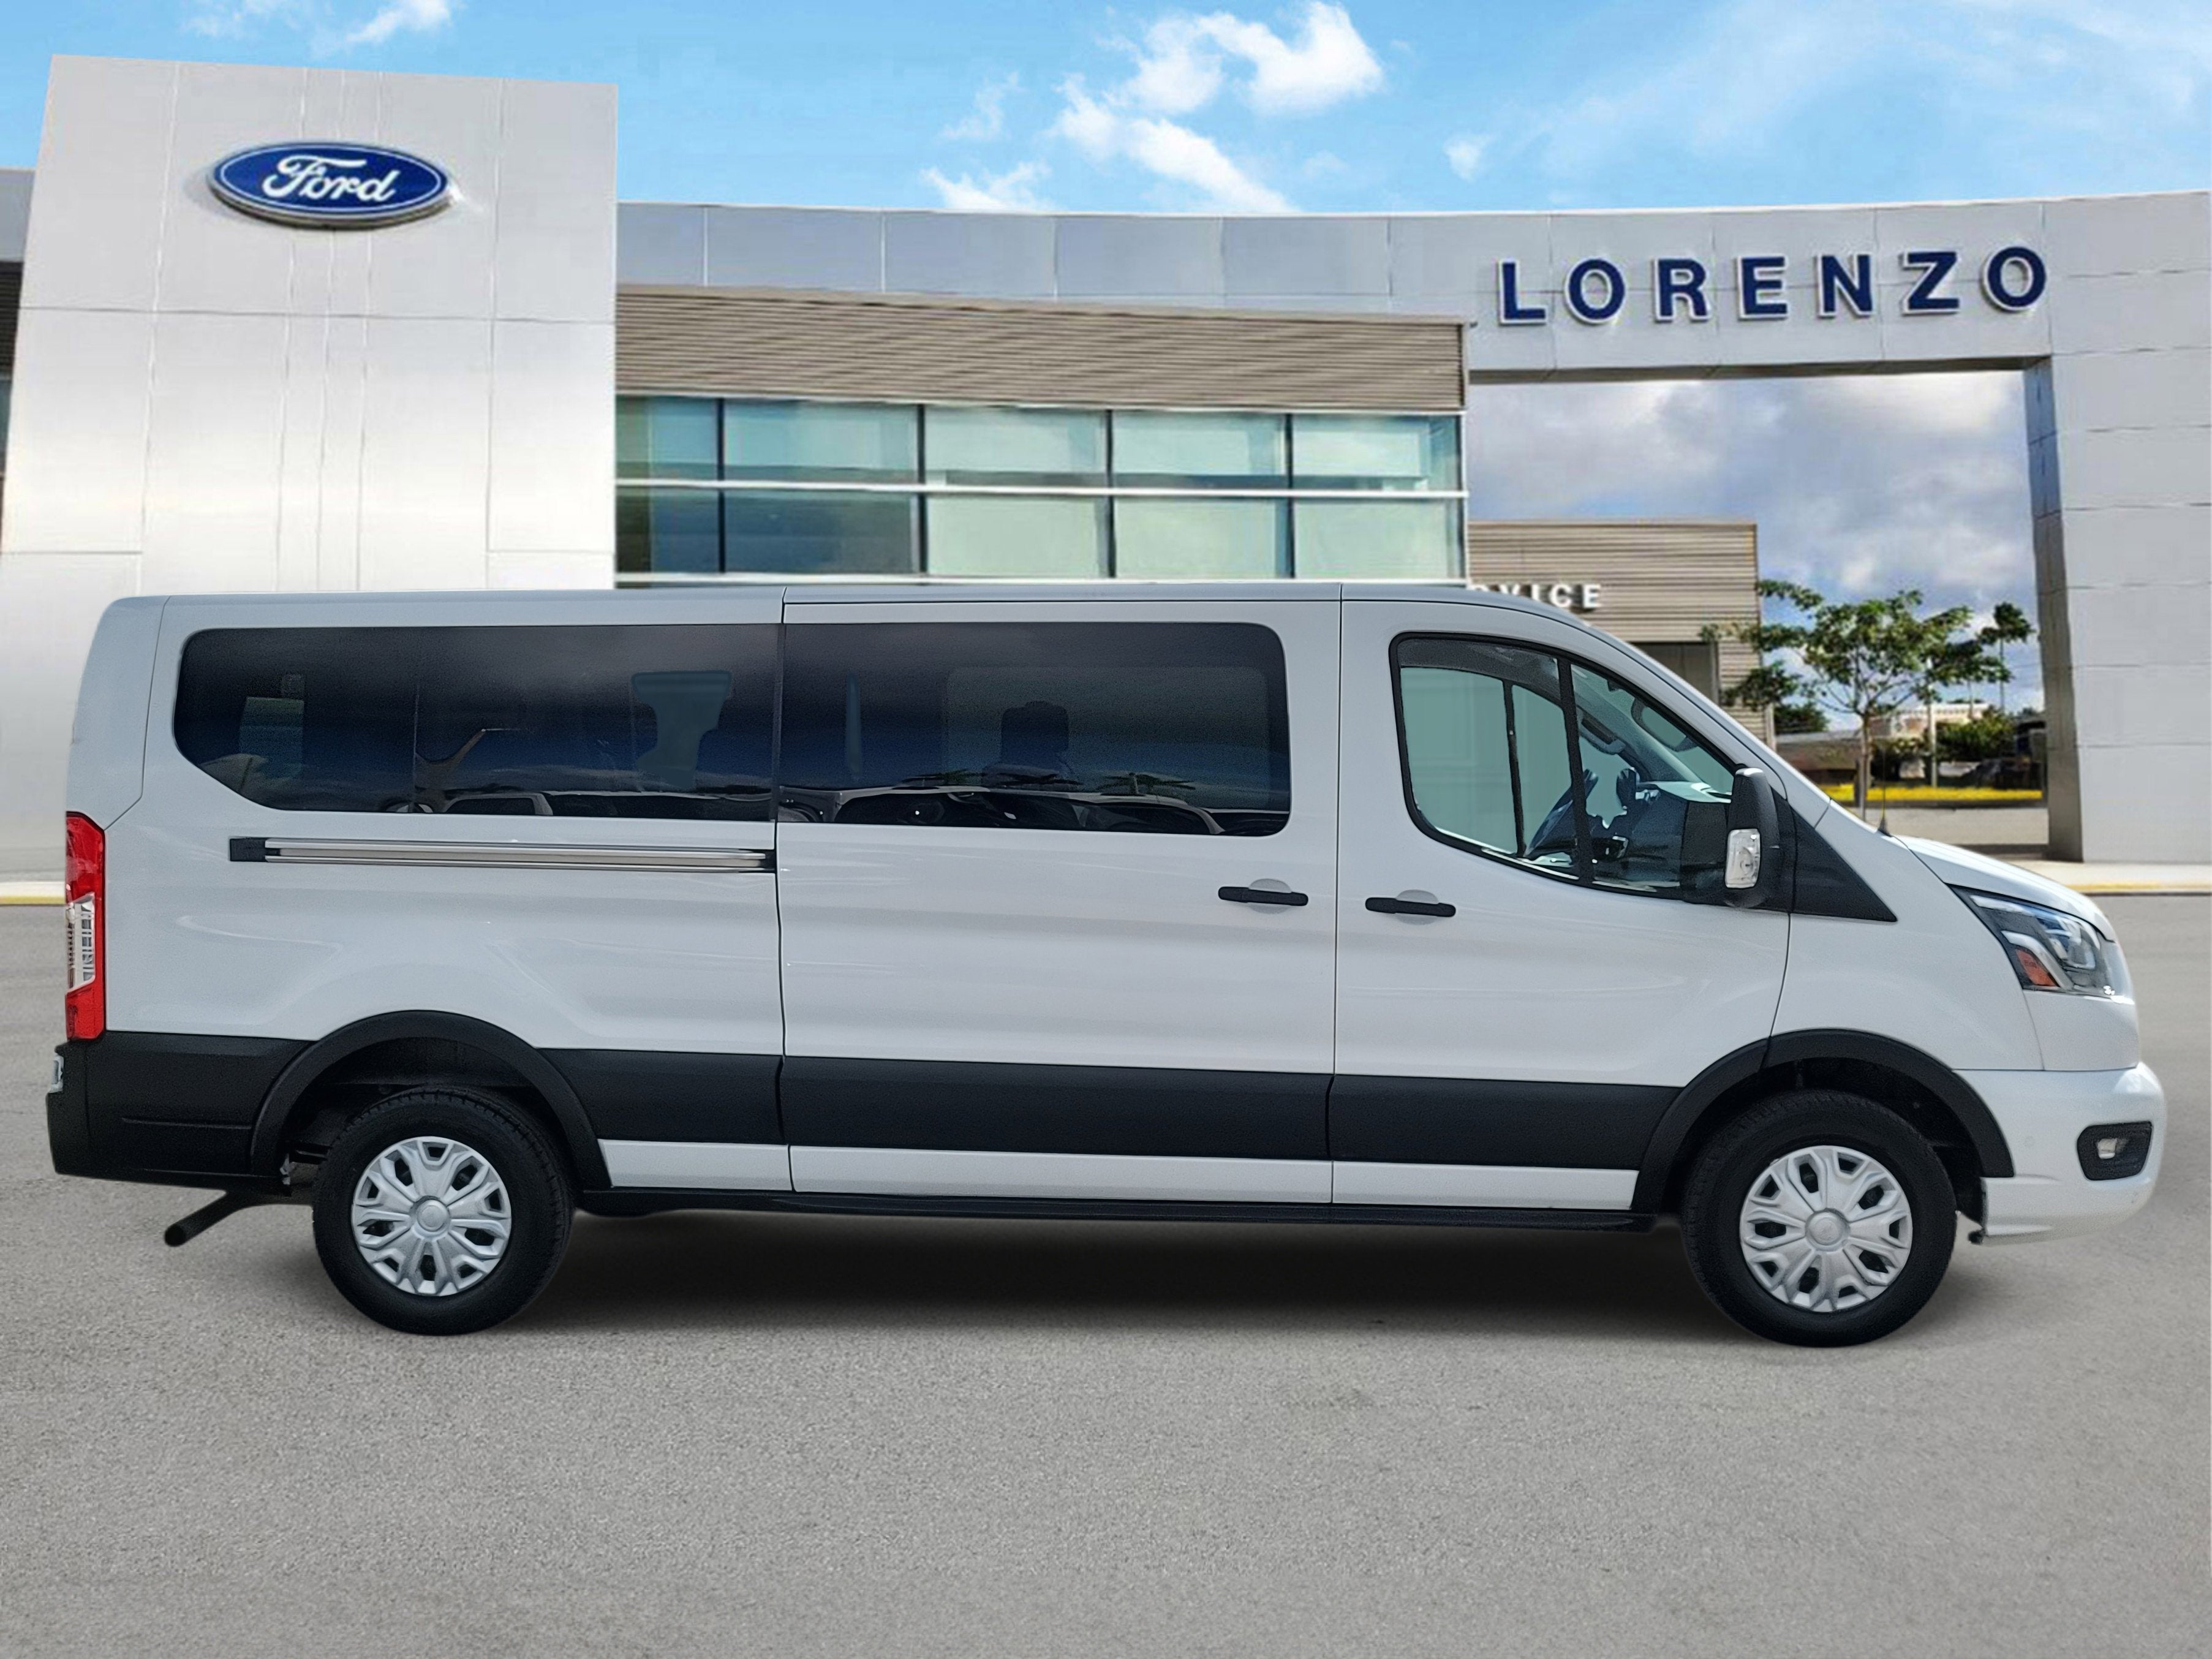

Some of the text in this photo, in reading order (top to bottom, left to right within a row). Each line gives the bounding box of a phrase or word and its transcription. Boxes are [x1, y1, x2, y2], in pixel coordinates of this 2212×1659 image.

[262, 155, 400, 202] Ford
[1498, 246, 2047, 324] LORENZO
[1468, 583, 1602, 608] VICE
